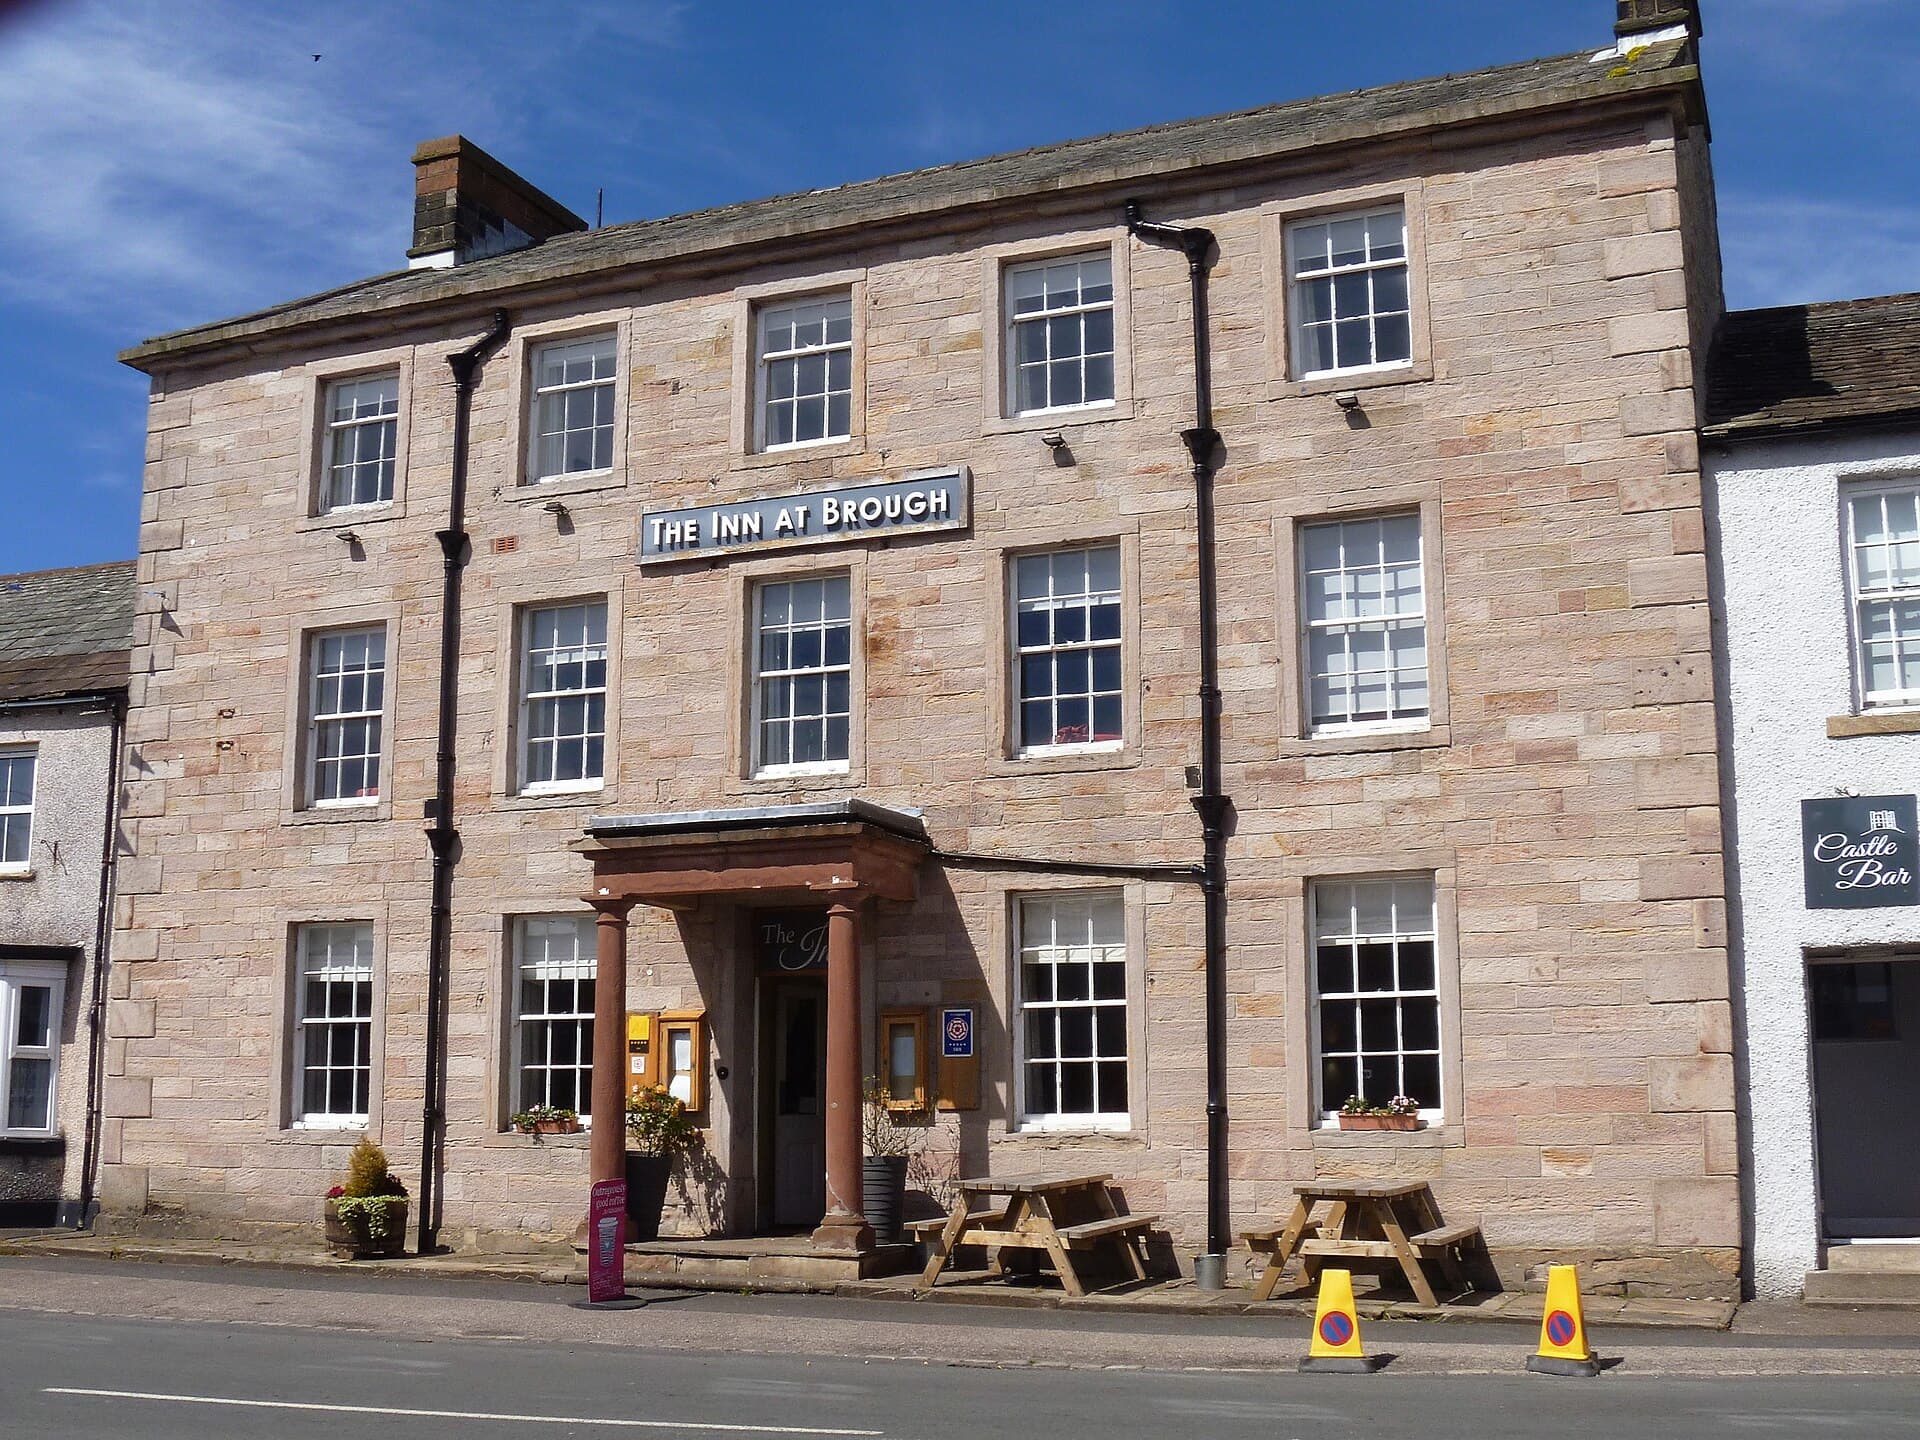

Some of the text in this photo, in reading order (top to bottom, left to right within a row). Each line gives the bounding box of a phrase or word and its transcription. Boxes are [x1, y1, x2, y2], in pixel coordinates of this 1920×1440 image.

[651, 488, 948, 545] THE INN AT BROUGH
[1813, 832, 1898, 863] Castle
[1835, 857, 1912, 890] Bar
[761, 923, 795, 944] The
